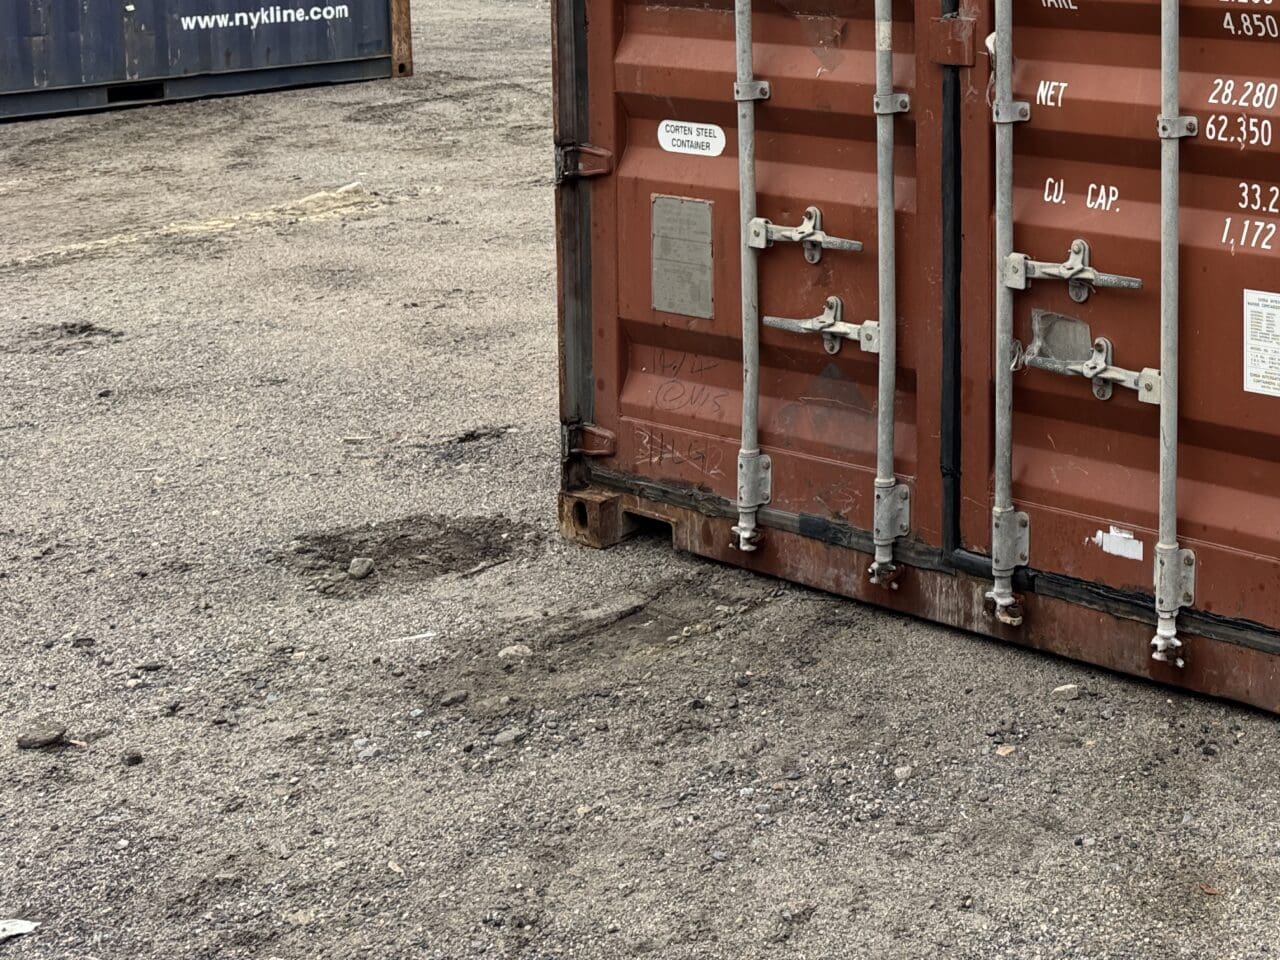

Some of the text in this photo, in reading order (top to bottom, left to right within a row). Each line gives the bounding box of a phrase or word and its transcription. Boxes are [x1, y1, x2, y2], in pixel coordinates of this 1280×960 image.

[181, 4, 349, 30] www.nykline.com
[1036, 80, 1068, 107] NET
[1207, 78, 1278, 109] 28,280
[664, 123, 718, 139] CORTEN STEEL
[671, 138, 711, 151] CONTAINER
[1205, 113, 1272, 148] 62,350
[1043, 178, 1066, 204] CU.
[1086, 183, 1120, 212] CAP.
[1238, 182, 1280, 213] 33.2
[1221, 217, 1276, 251] 1,172
